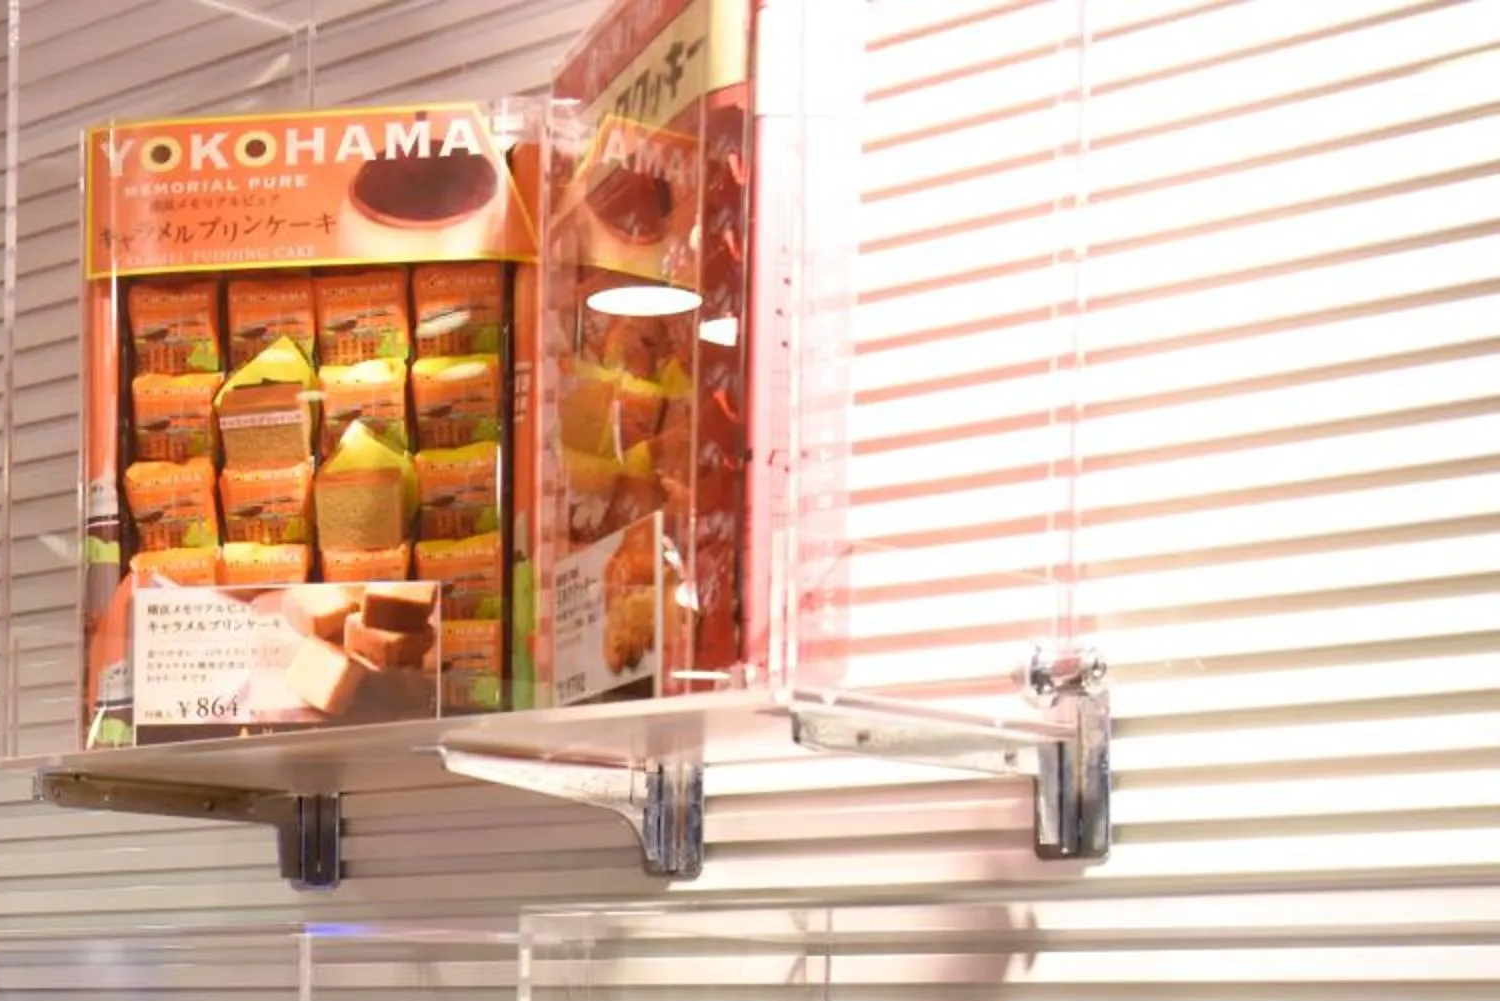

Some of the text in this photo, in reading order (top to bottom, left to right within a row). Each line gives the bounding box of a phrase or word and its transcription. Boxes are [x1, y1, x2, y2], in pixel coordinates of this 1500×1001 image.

[100, 117, 483, 178] YOKOHAMA
[124, 173, 309, 197] MEMORIAL PURE
